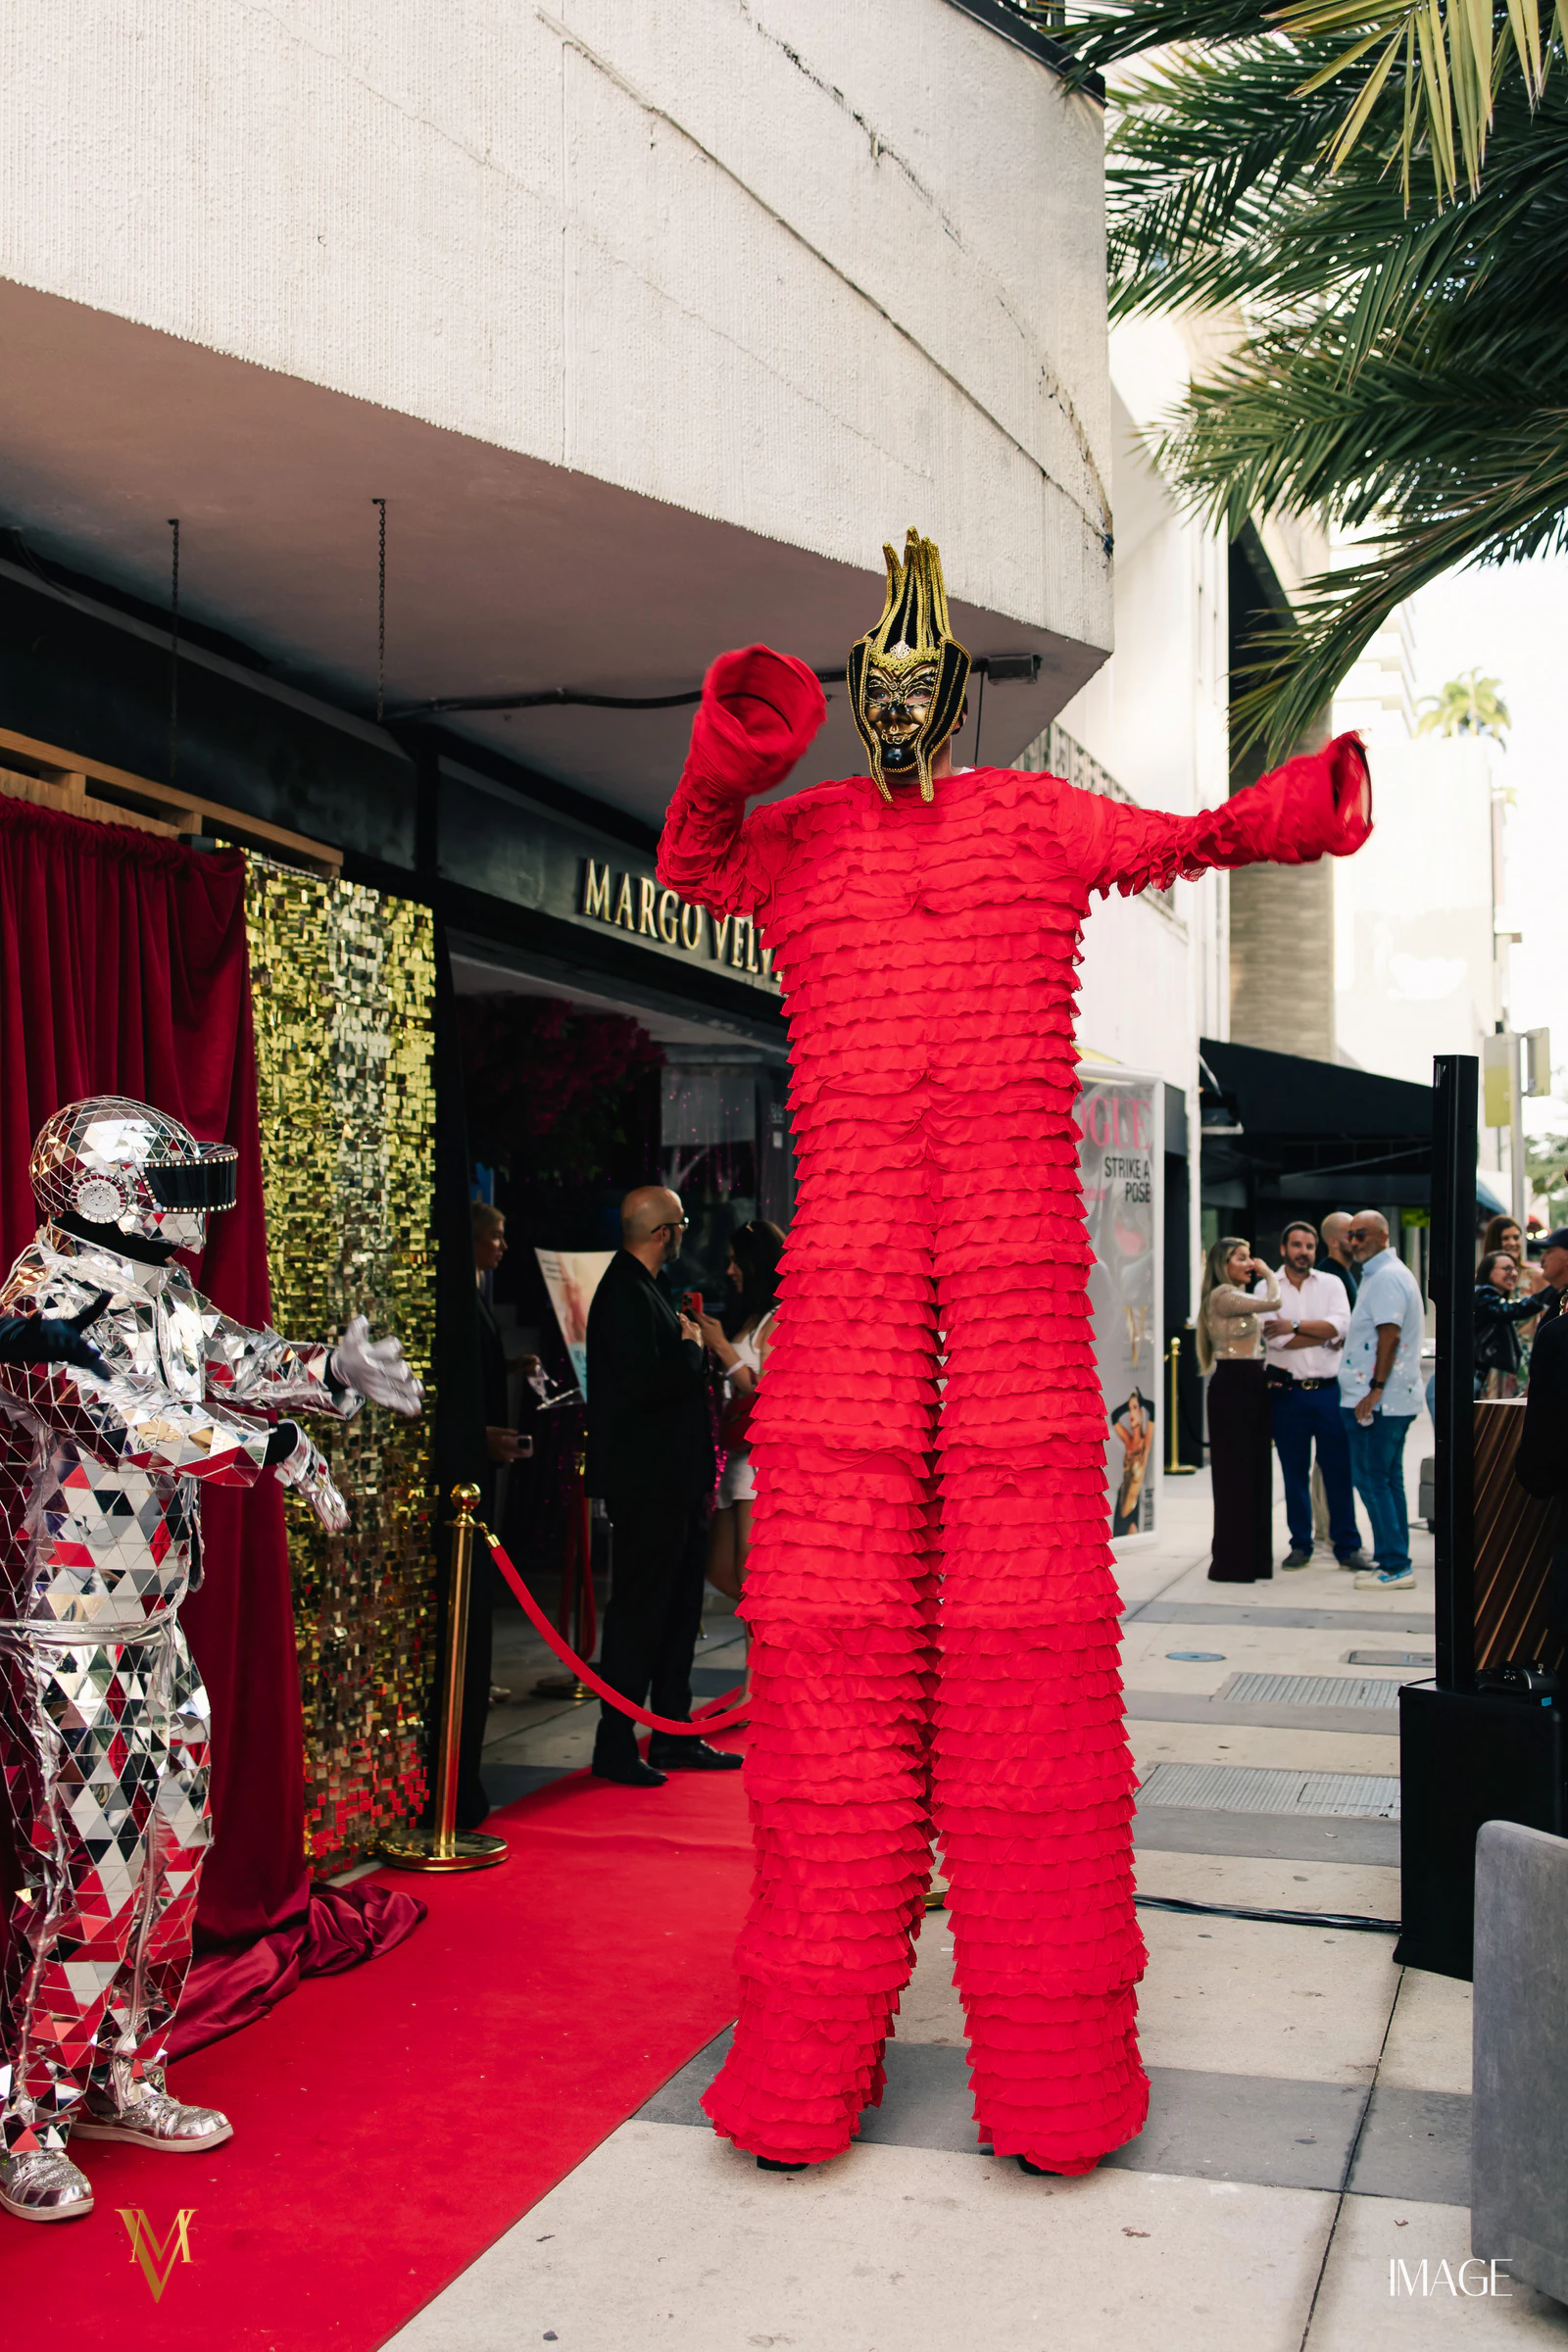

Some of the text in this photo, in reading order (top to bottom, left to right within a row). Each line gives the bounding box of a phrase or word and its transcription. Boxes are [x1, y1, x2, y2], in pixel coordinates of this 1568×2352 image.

[584, 858, 784, 983] MARGO VELV
[1077, 1094, 1151, 1151] GUE
[1104, 1156, 1151, 1180] STRIKE A
[1125, 1182, 1151, 1203] POSE
